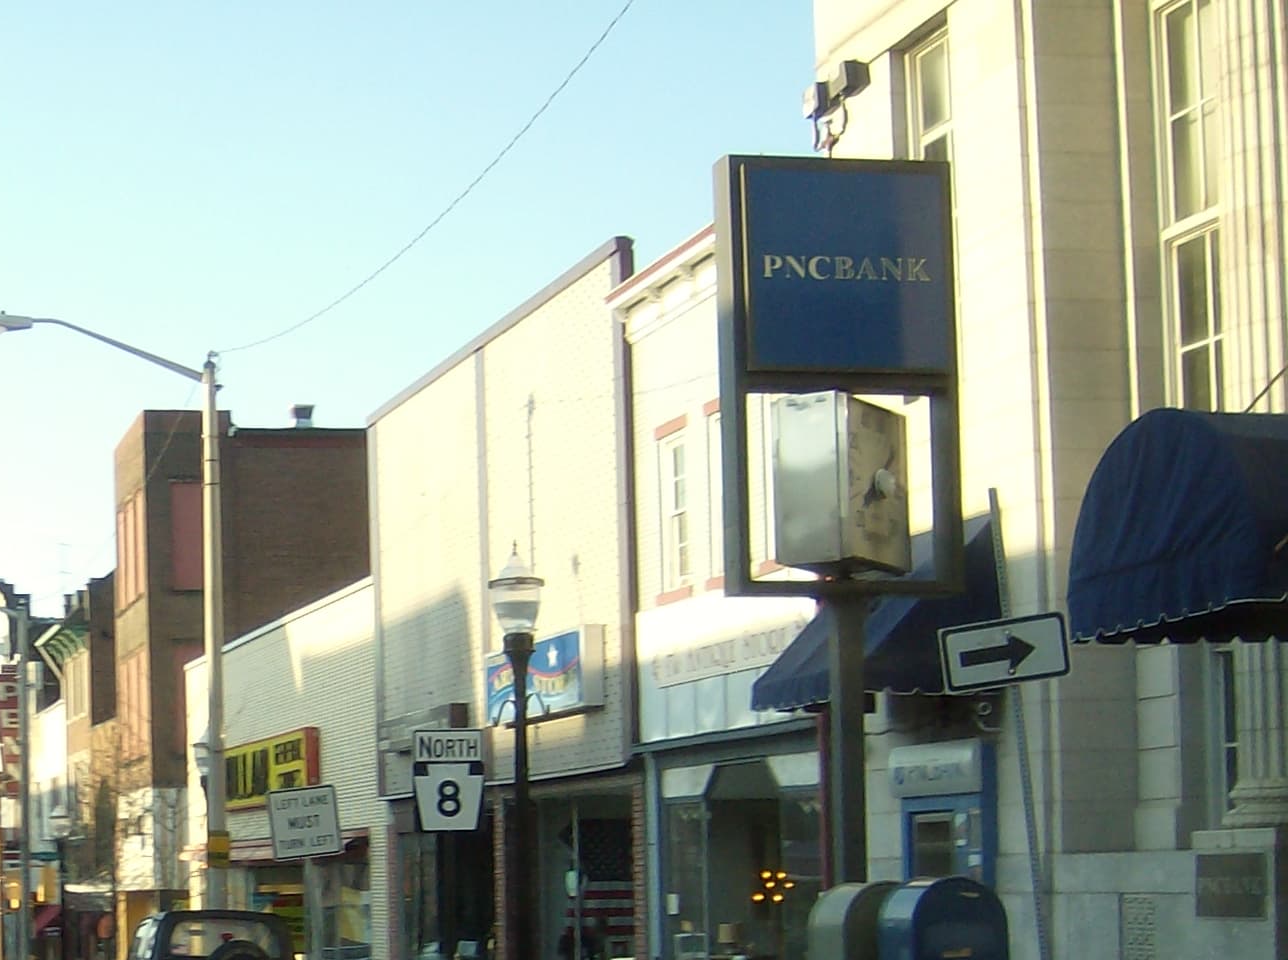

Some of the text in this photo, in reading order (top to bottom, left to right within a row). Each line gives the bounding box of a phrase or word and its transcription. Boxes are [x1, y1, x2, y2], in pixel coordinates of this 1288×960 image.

[763, 254, 931, 282] PNCBANK
[419, 736, 478, 758] NORTH
[274, 793, 329, 811] LEFT LANE
[437, 779, 461, 818] 8
[287, 814, 320, 831] MUST
[279, 833, 334, 851] TURN LEFT
